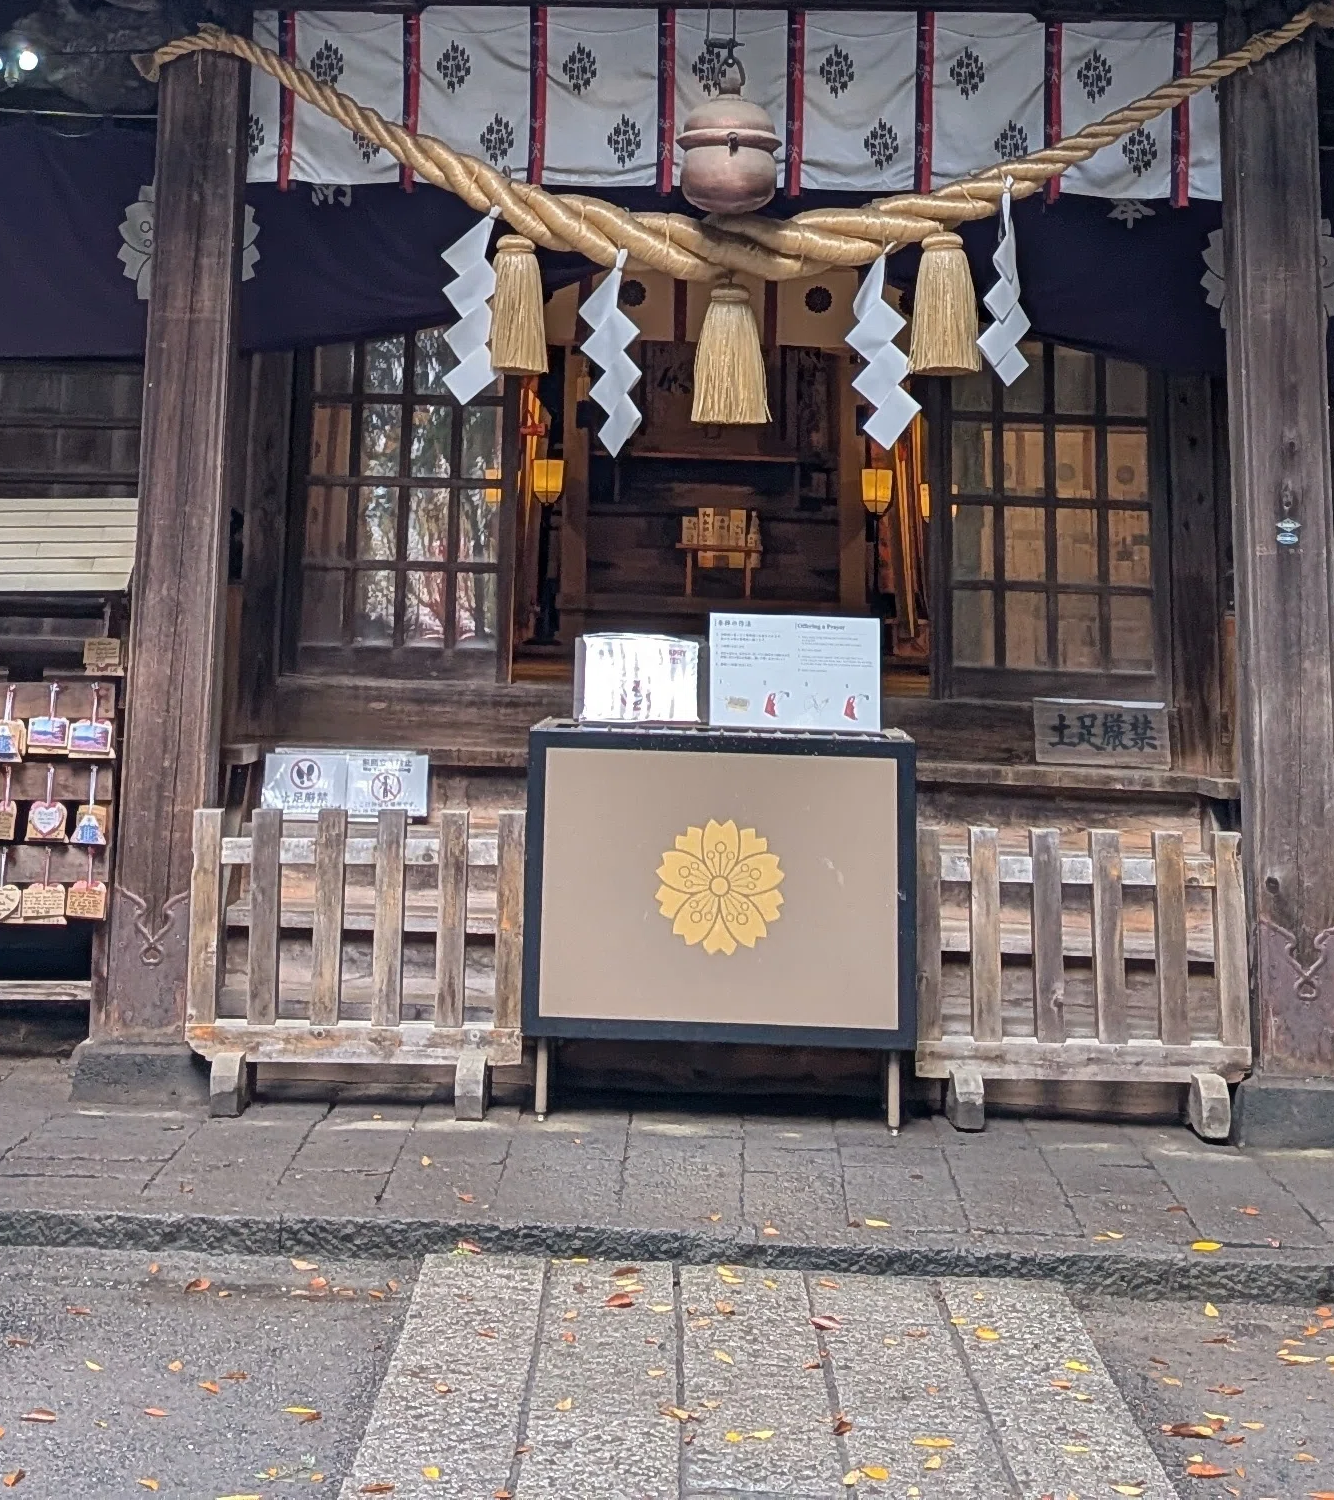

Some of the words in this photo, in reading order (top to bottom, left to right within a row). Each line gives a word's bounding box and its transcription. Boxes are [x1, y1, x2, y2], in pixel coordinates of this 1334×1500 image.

[797, 622, 821, 631] Offering
[827, 623, 845, 632] Prayer
[1048, 712, 1158, 752] 土足厳禁
